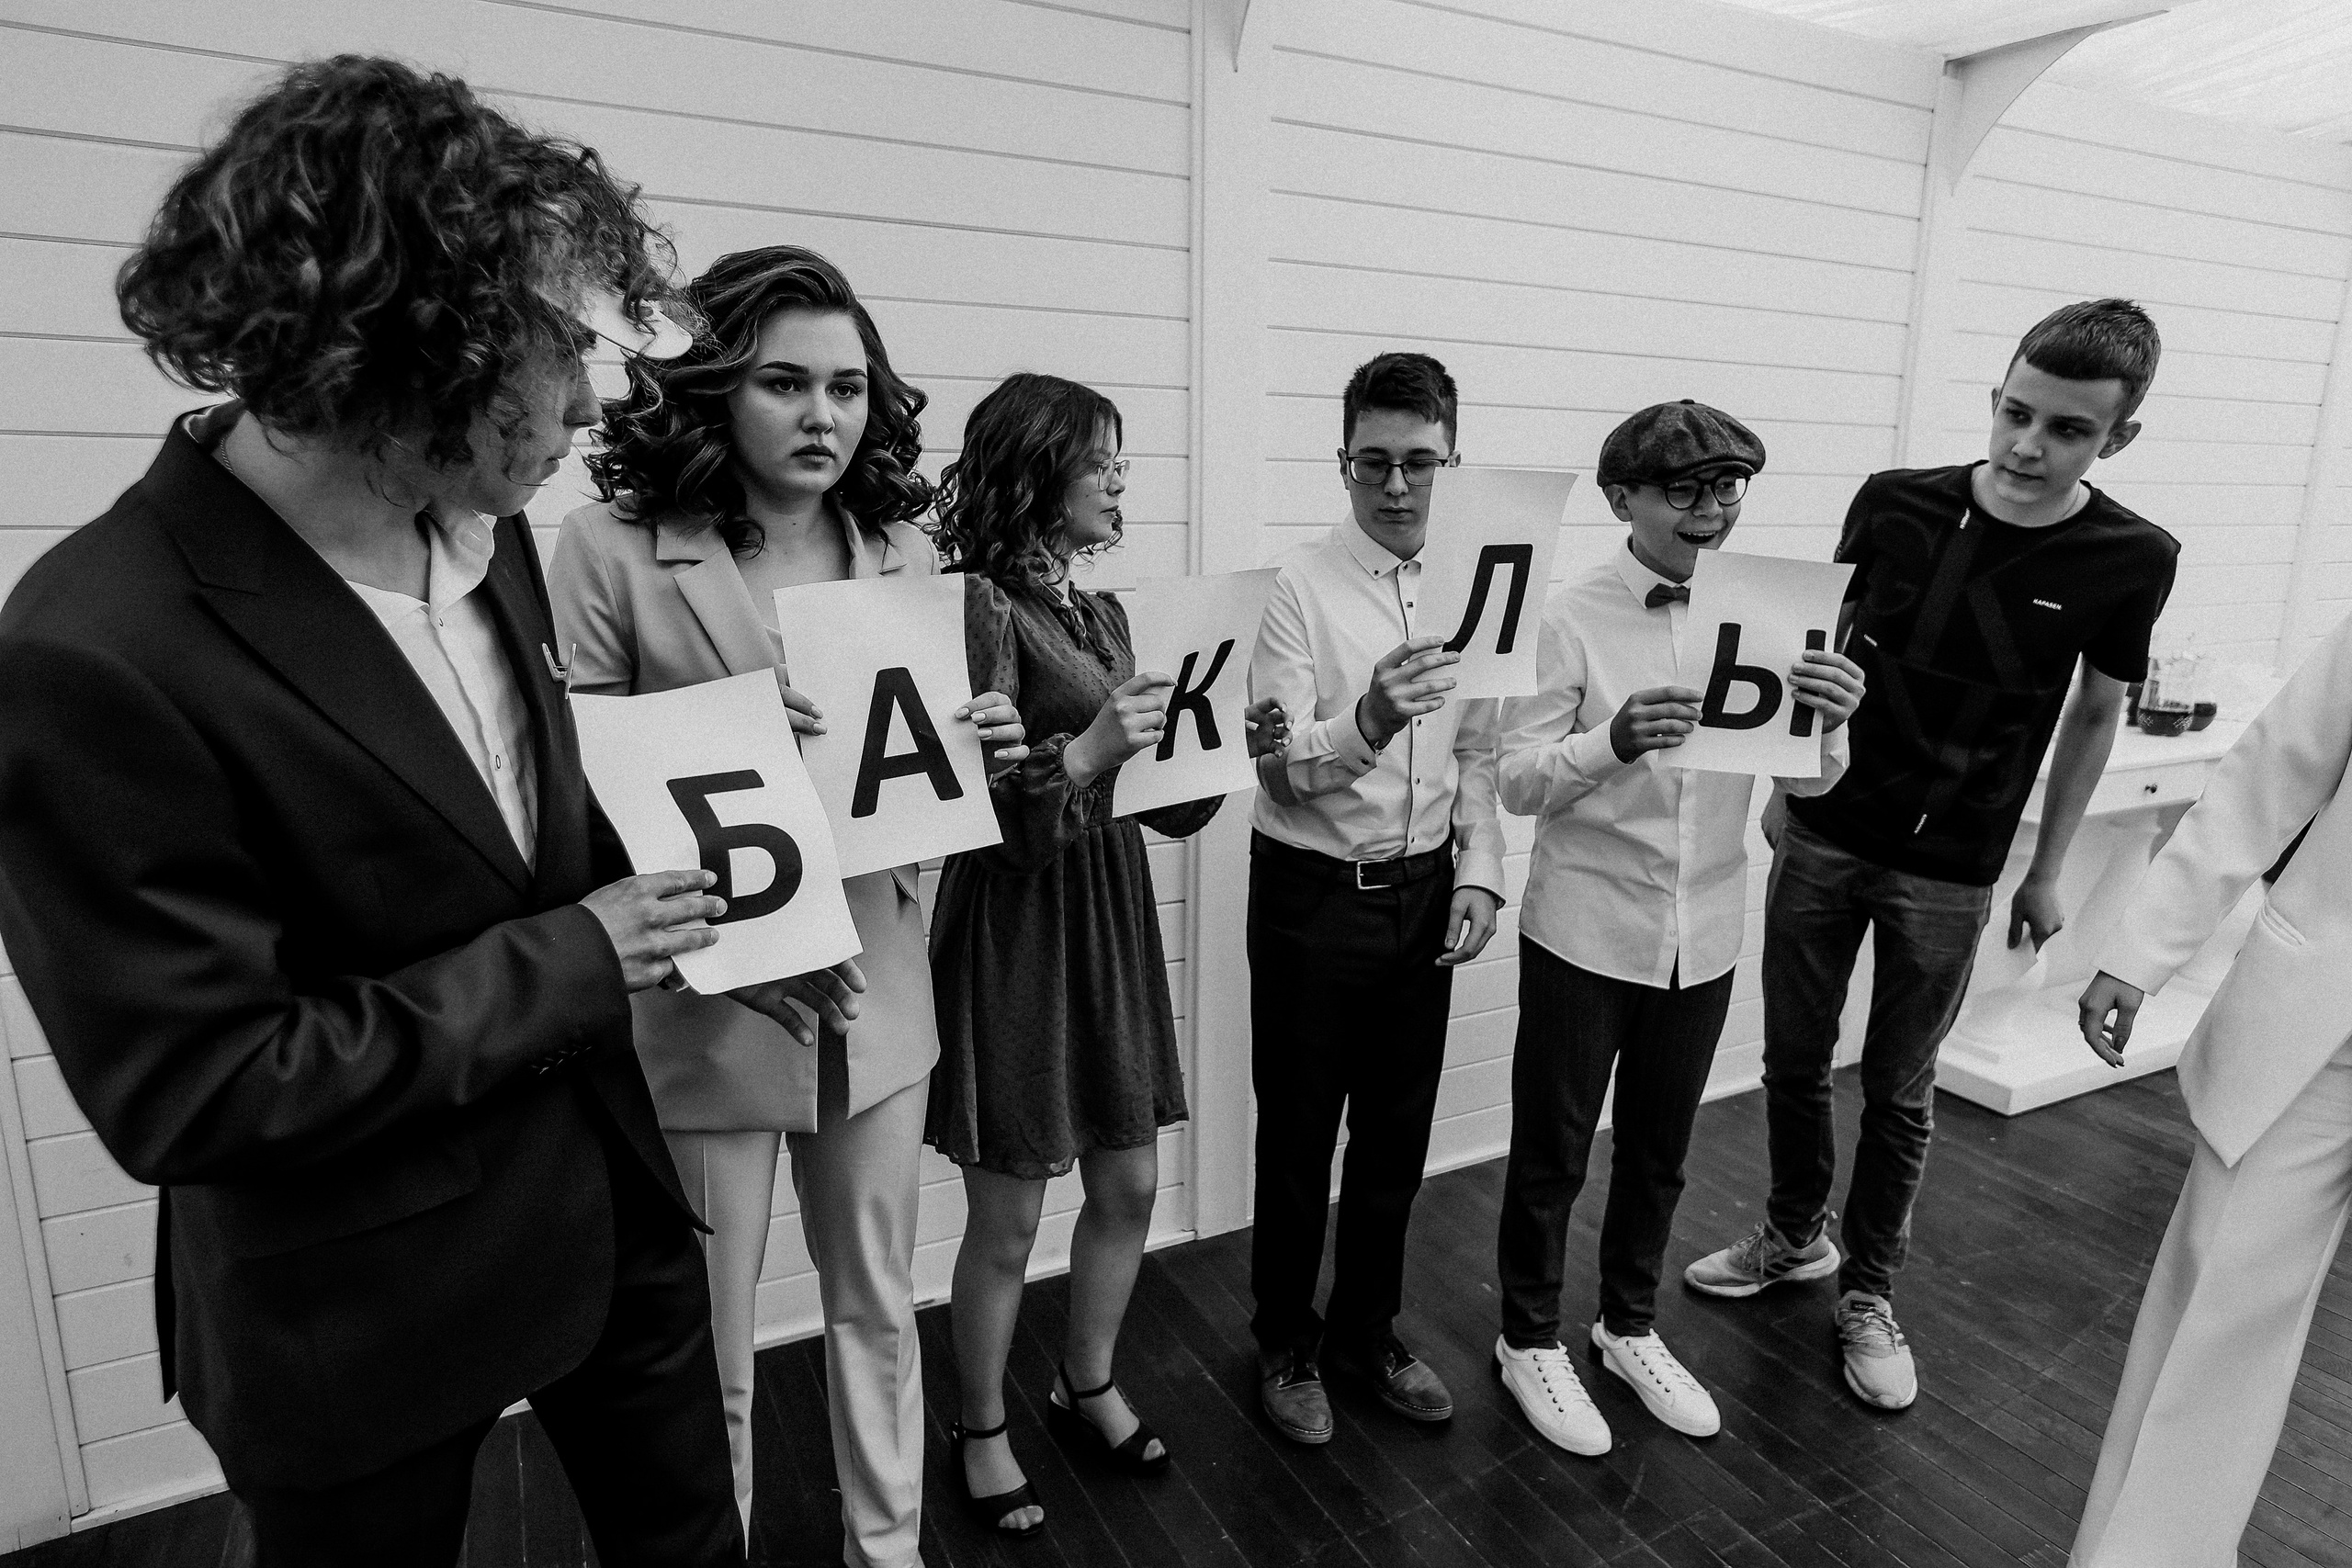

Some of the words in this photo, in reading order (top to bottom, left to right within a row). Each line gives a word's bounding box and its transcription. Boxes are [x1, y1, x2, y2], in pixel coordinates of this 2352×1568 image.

[1442, 544, 1532, 654] Л
[1155, 638, 1235, 761] К
[1698, 623, 1826, 737] Ы
[851, 667, 964, 818] А
[666, 769, 802, 926] Б
